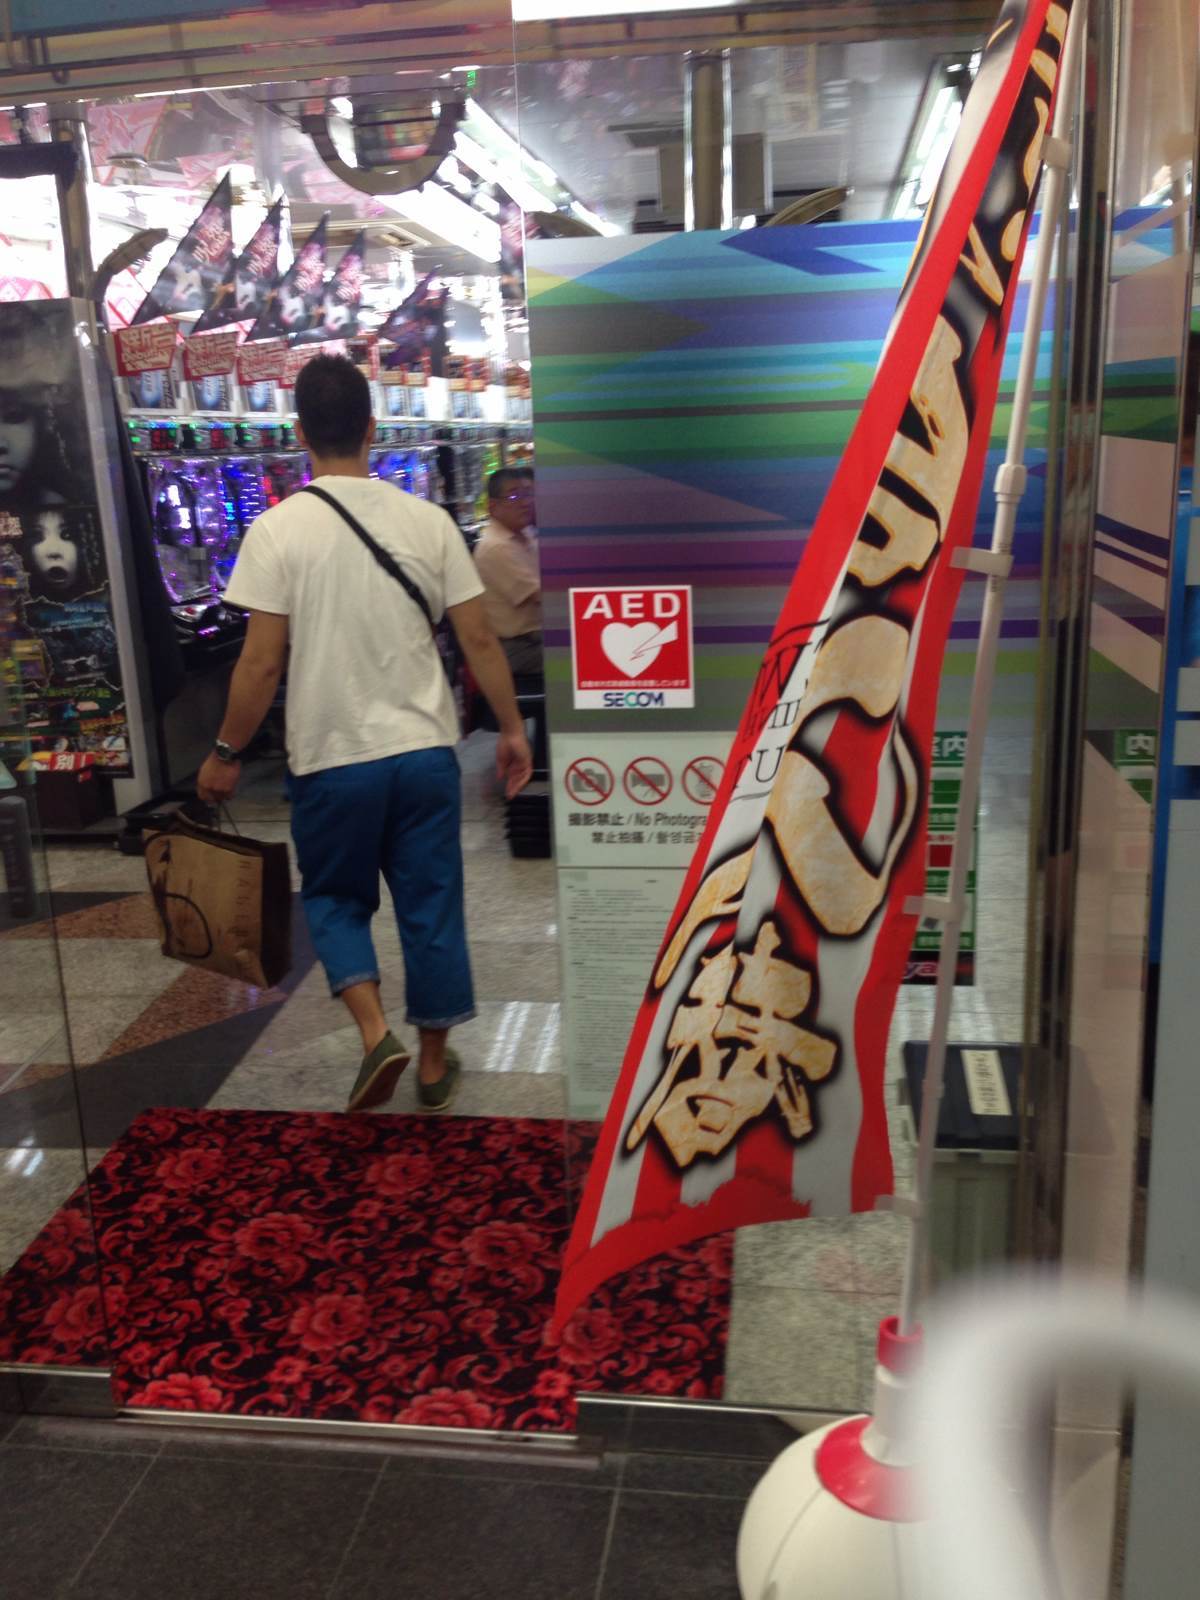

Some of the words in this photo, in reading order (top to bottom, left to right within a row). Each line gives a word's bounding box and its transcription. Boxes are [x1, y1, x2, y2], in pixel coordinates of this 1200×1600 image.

[582, 593, 681, 619] AED
[603, 692, 664, 707] SECOM
[654, 812, 706, 829] Photogra
